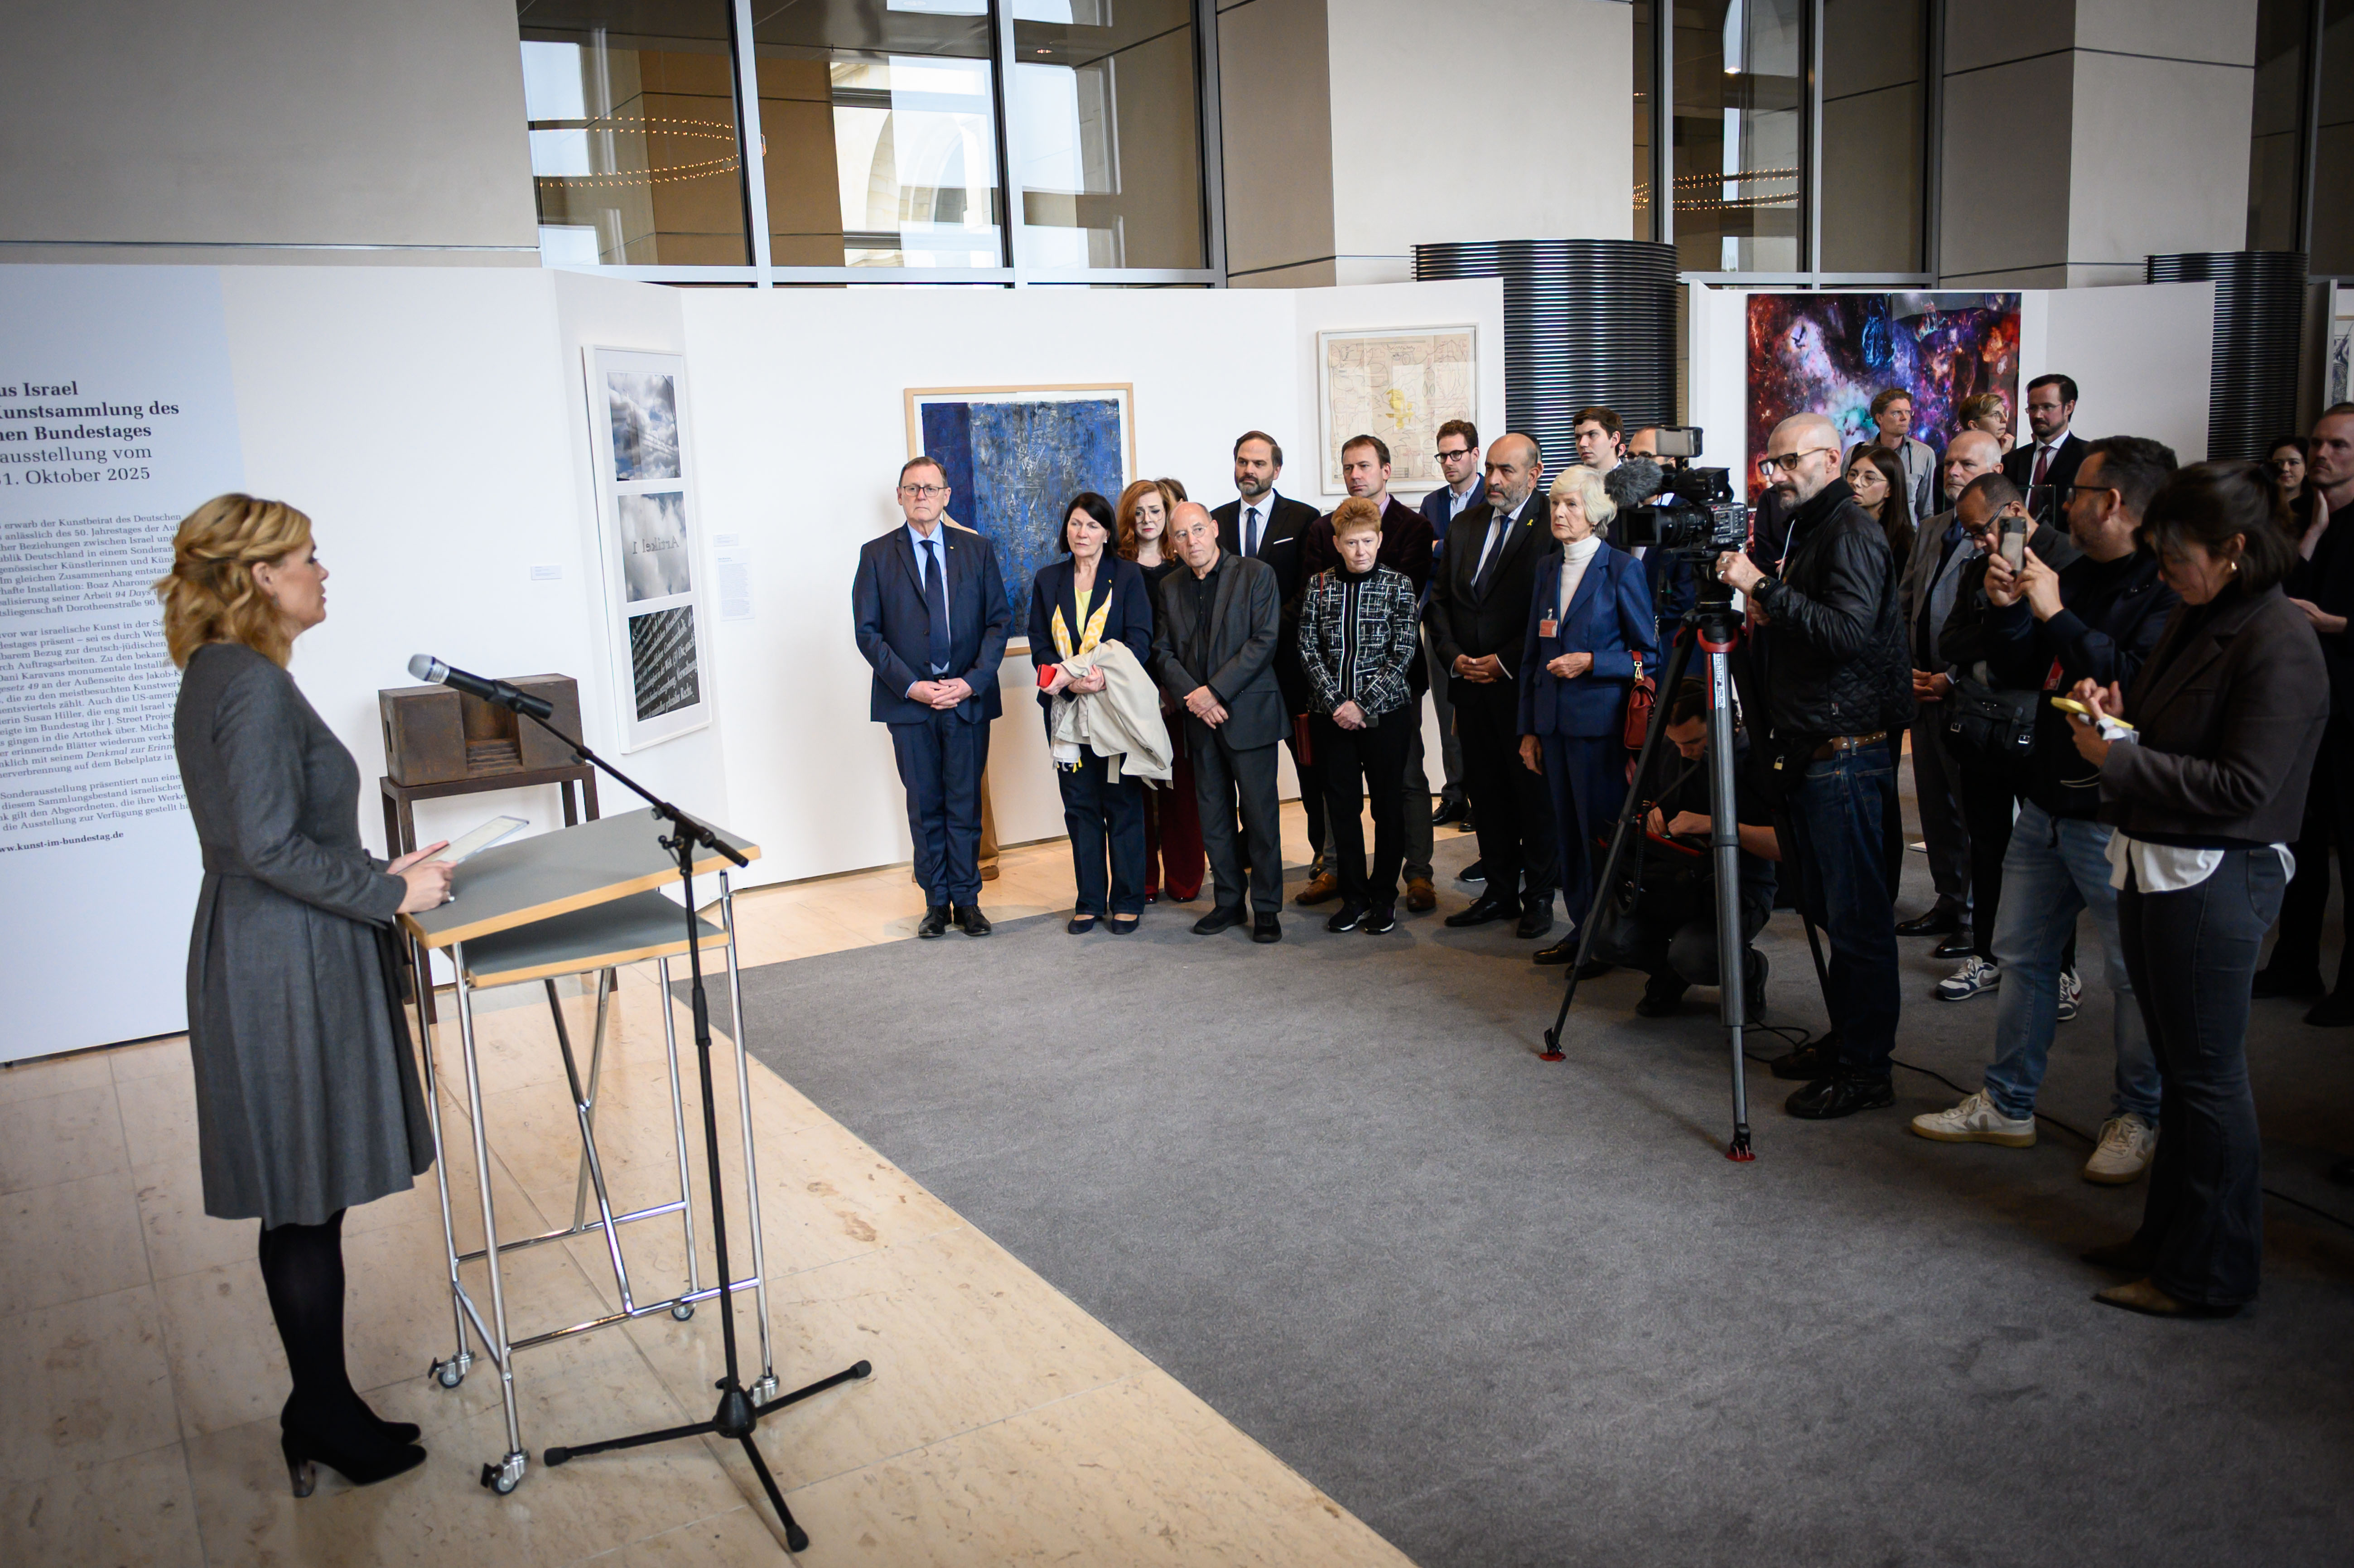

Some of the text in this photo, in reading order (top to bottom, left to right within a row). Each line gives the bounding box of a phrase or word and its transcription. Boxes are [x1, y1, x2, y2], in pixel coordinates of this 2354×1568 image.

[22, 380, 78, 396] Israel
[149, 400, 179, 415] des
[33, 424, 151, 442] Bundestages
[0, 446, 152, 464] ausstellung vom
[0, 467, 150, 485] 1. Oktober 2025
[4, 519, 38, 529] erwarb
[40, 519, 56, 528] der
[58, 516, 113, 526] Kunstbeirat
[115, 515, 131, 523] des
[133, 512, 181, 522] Deutschen
[5, 529, 53, 540] anlässlich
[55, 529, 72, 537] des
[91, 526, 142, 537] Jahrestages
[144, 524, 159, 533] der
[18, 540, 81, 550] Beziehungen
[82, 536, 127, 547] zwischen
[129, 534, 154, 544] Israel
[24, 542, 174, 561] Deutschland in einem Sonderan
[60, 559, 128, 569] Künstlerinnen
[130, 556, 149, 565] und
[150, 555, 174, 564] Küns
[14, 573, 56, 585] gleichen
[58, 569, 133, 580] Zusammenhang
[26, 583, 84, 593] Installation:
[86, 581, 110, 589] Boaz
[51, 593, 80, 603] seiner
[82, 590, 112, 600] Arbeit
[129, 589, 151, 598] Days
[65, 599, 142, 612] Dorotheenstraße
[40, 624, 91, 636] israelische
[92, 622, 121, 632] Kunst
[123, 621, 133, 629] in
[135, 620, 150, 628] der
[39, 637, 75, 648] präsent
[85, 634, 99, 642] sei
[113, 630, 140, 640] durch
[0, 652, 31, 661] barem
[32, 649, 63, 657] Bezug
[82, 639, 166, 653] deutsch-jüdischen
[17, 650, 168, 670] Auftragsarbeiten. Zu den bekann
[21, 671, 65, 680] Karavans
[67, 663, 131, 676] monumentale
[27, 682, 39, 690] 49
[55, 679, 71, 688] der
[73, 674, 125, 686] Außenseite
[128, 672, 144, 681] des
[5, 694, 22, 703] die
[38, 691, 57, 700] den
[58, 685, 131, 698] meistbesuchten
[0, 701, 56, 714] entsviertels
[58, 699, 85, 709] zählt.
[87, 696, 112, 706] Auch
[115, 695, 130, 703] die
[23, 714, 52, 723] Susan
[53, 710, 84, 720] Hiller,
[86, 708, 101, 716] die
[122, 704, 138, 713] mit
[140, 701, 165, 711] Israel
[24, 725, 38, 733] im
[39, 721, 90, 732] Bundestag
[91, 718, 105, 727] ihr
[107, 717, 114, 727] J.
[116, 715, 143, 724] Street
[145, 712, 171, 721] Projec
[7, 737, 39, 748] gingen
[41, 734, 52, 743] in
[54, 732, 69, 741] die
[72, 727, 113, 739] Artothek
[115, 726, 138, 735] über.
[140, 722, 169, 732] Micha
[11, 743, 63, 756] erinnernde
[65, 741, 97, 750] Blätter
[99, 736, 146, 747] wiederum
[31, 755, 47, 765] mit
[50, 753, 84, 762] seinem
[86, 746, 127, 758] Denkmal
[74, 761, 89, 770] auf
[91, 760, 111, 768] dem
[113, 754, 162, 766] Bebelplatz
[164, 753, 173, 761] in
[0, 784, 87, 800] Sonderausstellung
[89, 777, 138, 791] präsentiert
[1, 783, 182, 810] diesem Sammlungsbestand israelischer
[2, 822, 18, 831] die
[20, 816, 77, 829] Ausstellung
[96, 809, 144, 820] Verfügung
[145, 803, 177, 815] gestellt
[11, 810, 27, 822] gilt
[29, 808, 48, 817] den
[50, 802, 118, 815] Abgeordneten,
[120, 798, 135, 807] die
[137, 796, 155, 805] ihre
